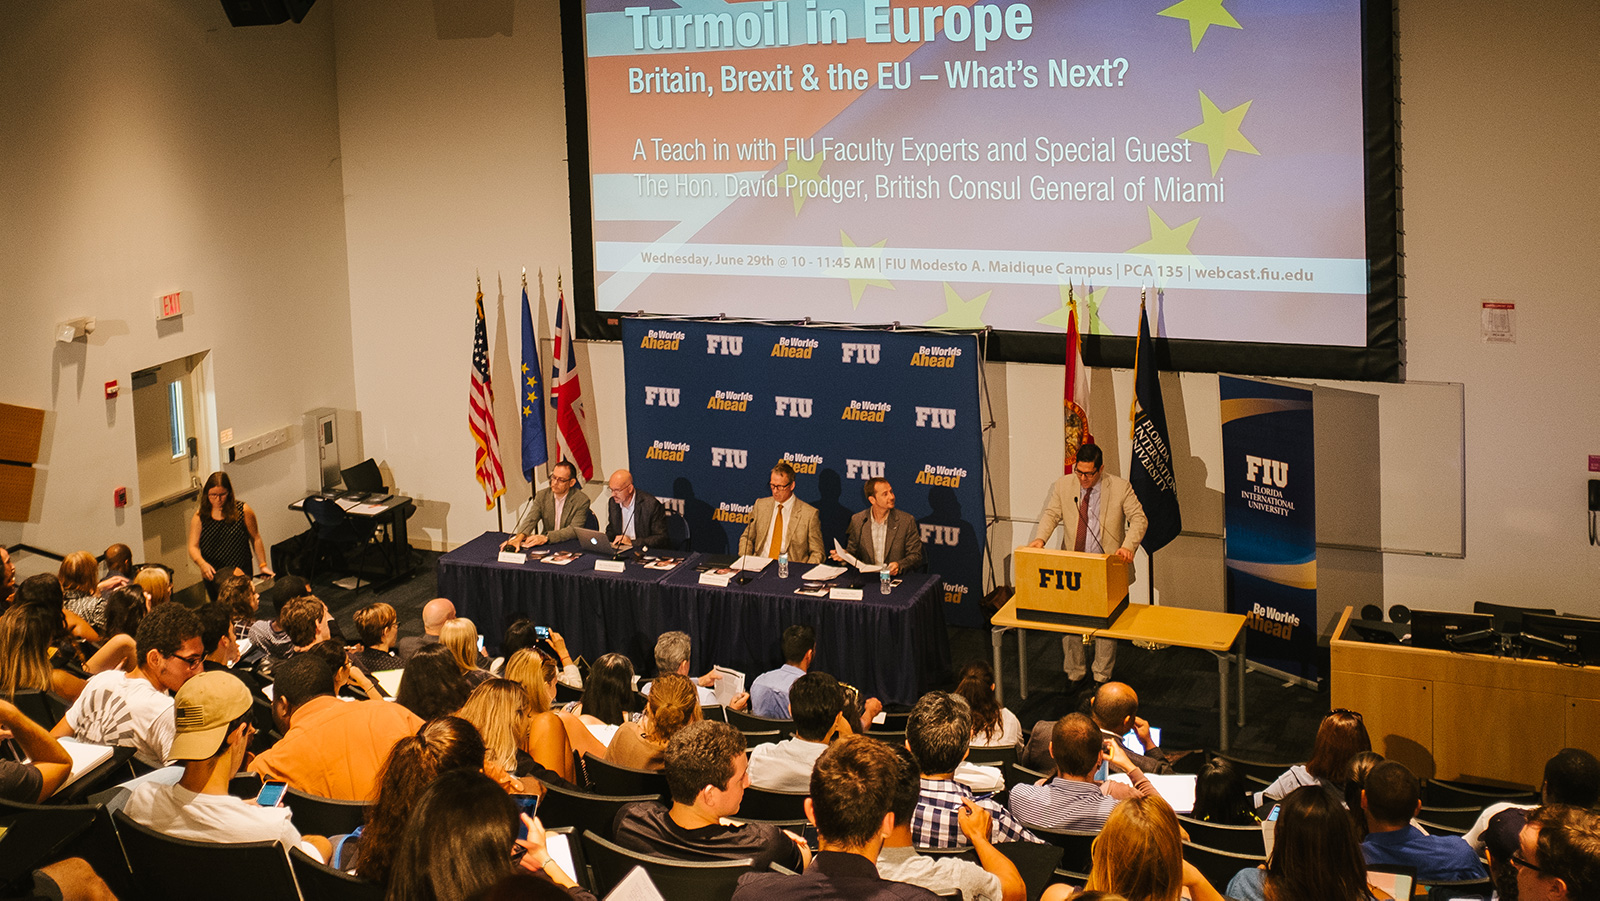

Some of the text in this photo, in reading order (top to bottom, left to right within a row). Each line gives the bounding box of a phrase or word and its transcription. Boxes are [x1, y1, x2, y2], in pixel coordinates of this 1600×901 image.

[625, 0, 1033, 52] Turmoil in Europe
[628, 66, 714, 97] Britain,
[721, 64, 793, 92] Brexit
[801, 65, 819, 91] &
[827, 64, 868, 90] the
[878, 62, 912, 90] EU
[1049, 58, 1129, 87] Next?
[633, 137, 1192, 167] A Teach in with FIU Faculty Experts and Special Guest
[634, 174, 1224, 203] The Hon. David Prodger, British Consul General of Miami
[641, 252, 712, 267] Wednesday,
[715, 254, 744, 266] June
[747, 255, 774, 267] 29th
[777, 256, 788, 268] @
[791, 257, 806, 268] 10
[817, 256, 851, 269] 11:45
[854, 257, 876, 269] AM
[885, 258, 906, 270] FIU
[910, 258, 968, 272] Modesto
[971, 260, 985, 272] A.
[989, 260, 1052, 276] Maidique
[1056, 262, 1113, 278] Campus
[1124, 264, 1153, 277] PCA
[1157, 265, 1183, 278] 135
[1195, 266, 1314, 281] webcast.fiu.edu
[163, 292, 181, 316] EXIT
[641, 336, 680, 351] Ahead
[648, 330, 685, 341] Be Worlds
[707, 334, 743, 356] FIU
[779, 337, 819, 349] Be Worlds
[771, 344, 813, 359] Ahead
[841, 343, 881, 365] FIU
[910, 353, 955, 368] Ahead
[919, 346, 962, 357] Be Worlds
[645, 386, 681, 408] FIU
[707, 396, 747, 412] Ahead
[715, 390, 753, 402] Be Worlds
[850, 400, 892, 412] Be Worlds
[775, 396, 813, 419] FIU
[842, 406, 886, 423] Ahead
[915, 406, 956, 430] FIU
[653, 440, 690, 452] Be Worlds
[1143, 420, 1170, 463] FLORIDA
[646, 446, 685, 462] Ahead
[711, 447, 748, 470] FIU
[784, 452, 823, 464] Be Worlds
[1133, 437, 1168, 491] NIVERSITY
[1135, 425, 1177, 495] INTERNATION
[846, 459, 885, 480] FIU
[915, 470, 960, 488] Ahead
[925, 464, 967, 478] Be Worlds
[1246, 455, 1289, 488] FIU
[1241, 490, 1295, 510] INTERNATIONAL
[1253, 485, 1283, 498] FLORIDA
[712, 508, 752, 524] Ahead
[720, 502, 754, 513] Be World
[1248, 501, 1289, 517] UNIVERSITY
[919, 523, 960, 547] FIU
[1039, 568, 1082, 591] FIU
[1243, 610, 1293, 640] Ahead
[1253, 602, 1300, 627] Be Worlds
